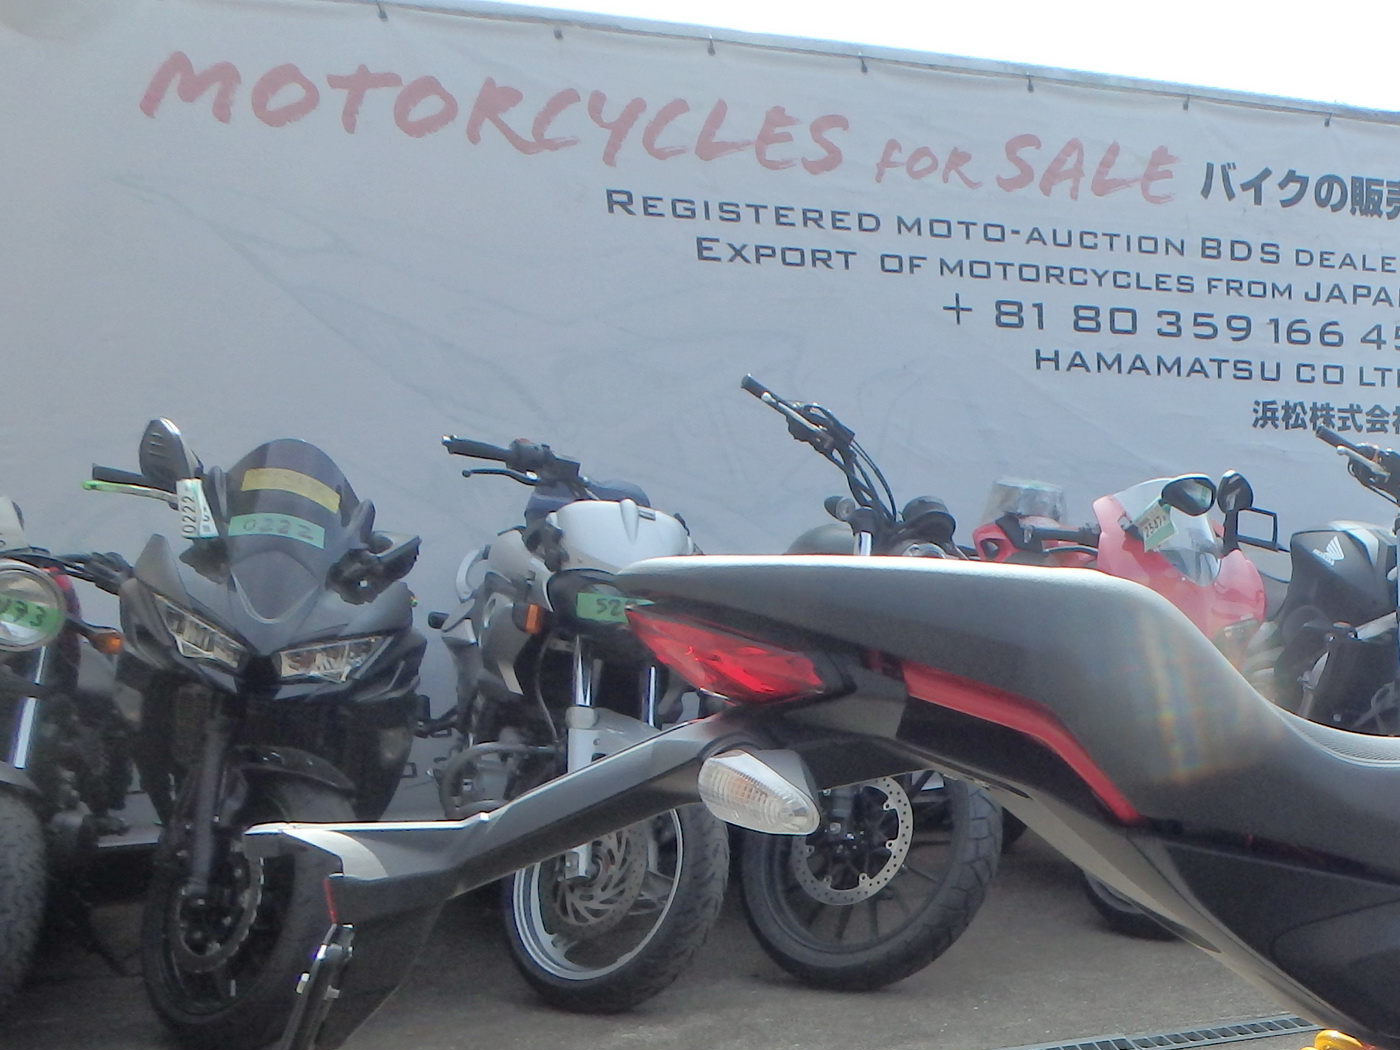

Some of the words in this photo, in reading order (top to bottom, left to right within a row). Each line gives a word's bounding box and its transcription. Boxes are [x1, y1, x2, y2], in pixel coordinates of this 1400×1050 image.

[140, 51, 849, 175] MOTORCYCLES
[875, 139, 982, 189] FOR
[996, 134, 1181, 204] SALE
[606, 189, 881, 232] REGISTERED
[897, 215, 1184, 256] MOTO-AUCTION
[1201, 237, 1280, 264] BDS
[697, 236, 857, 270] EXPORT
[880, 254, 927, 274] OF
[940, 257, 1194, 293] MOTORCYCLES
[1207, 277, 1292, 301] FROM
[943, 293, 972, 325] +
[995, 300, 1044, 330] 81
[1073, 305, 1137, 335] 80
[1157, 310, 1251, 341] 359
[1268, 318, 1344, 347] 166
[1035, 349, 1281, 382] HAMAMATSU
[1296, 363, 1344, 385] CO
[182, 496, 196, 533] 0222
[243, 518, 314, 541] 0222
